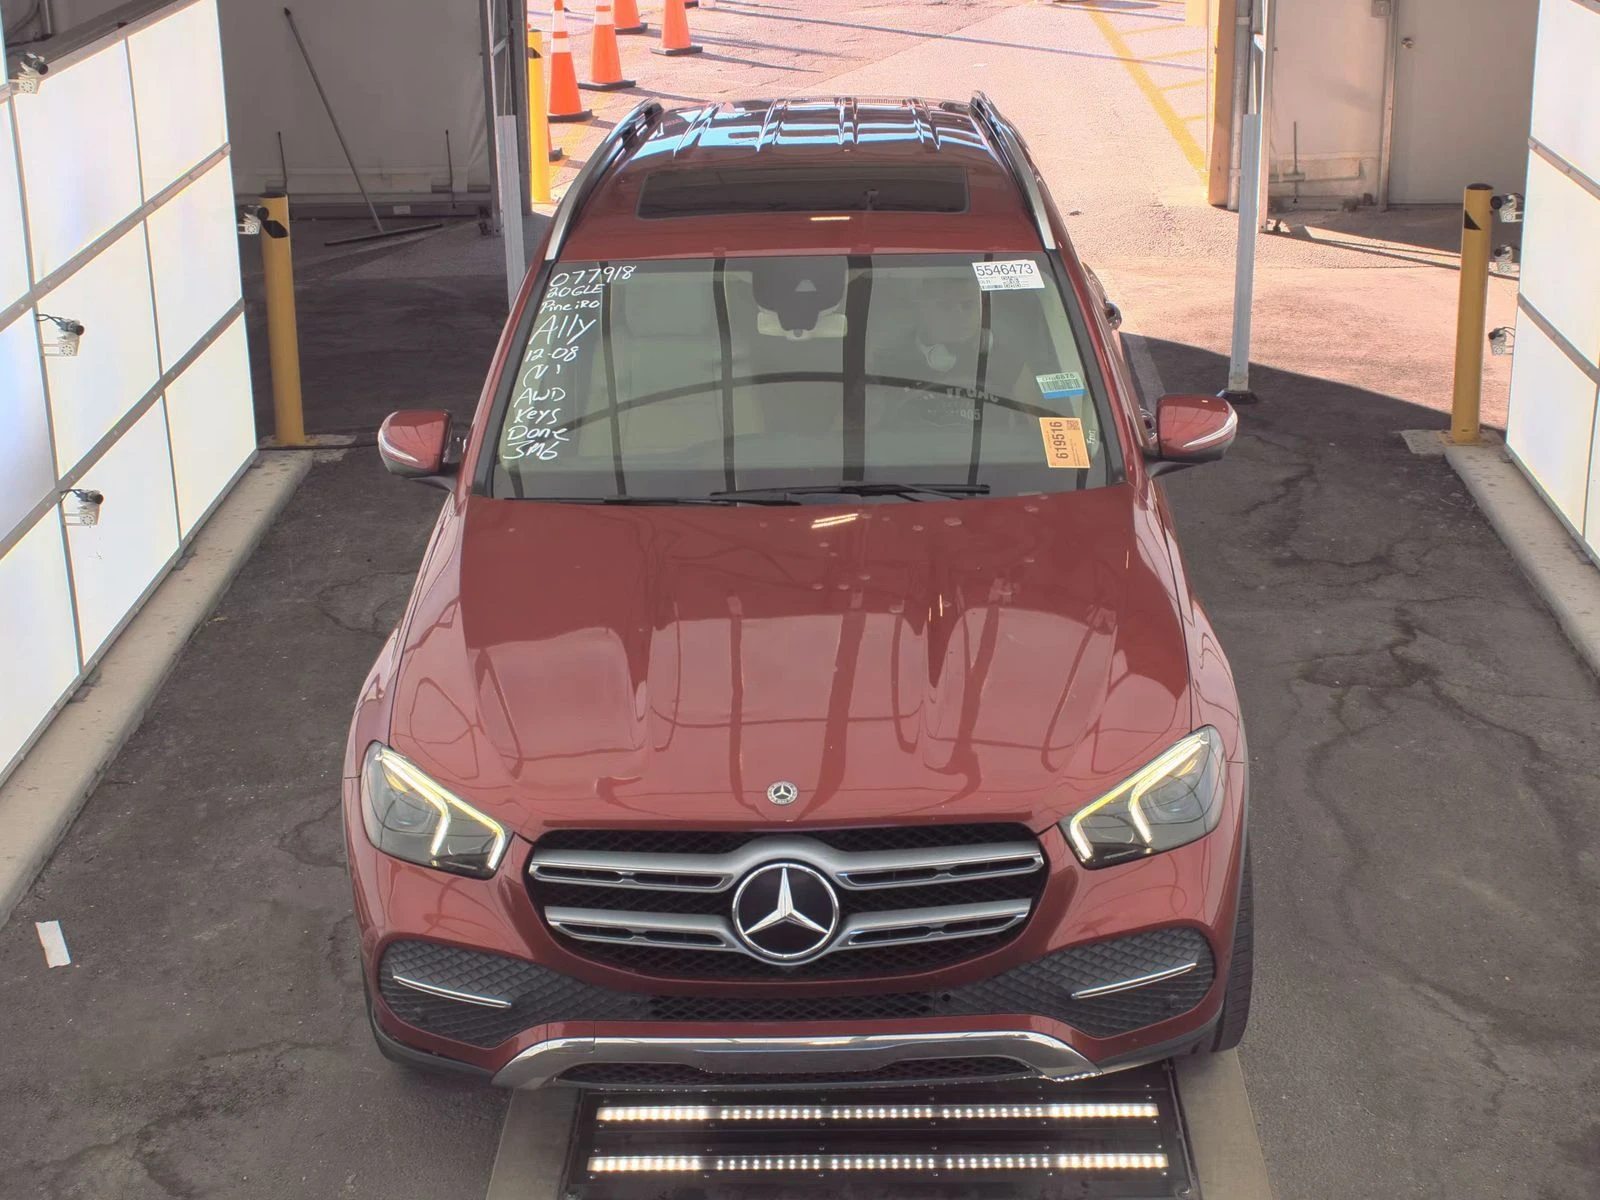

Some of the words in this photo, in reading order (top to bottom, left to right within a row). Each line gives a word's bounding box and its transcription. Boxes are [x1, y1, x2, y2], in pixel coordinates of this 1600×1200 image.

[549, 265, 637, 288] 077918
[976, 262, 1034, 277] 5546473
[528, 313, 598, 346] Ally
[513, 387, 567, 408] AWD
[507, 425, 570, 442] Done
[1049, 421, 1069, 459] 619516
